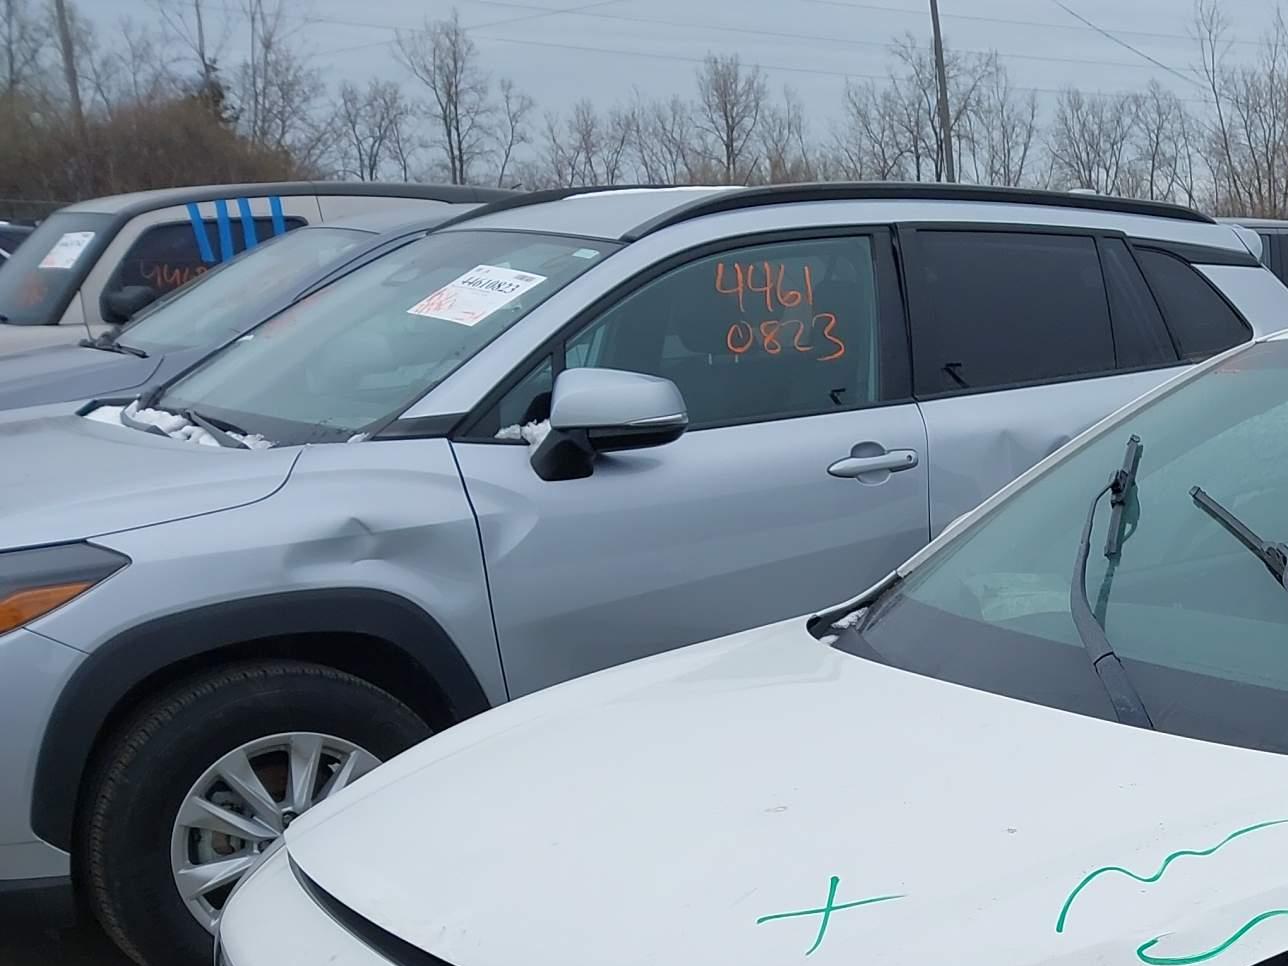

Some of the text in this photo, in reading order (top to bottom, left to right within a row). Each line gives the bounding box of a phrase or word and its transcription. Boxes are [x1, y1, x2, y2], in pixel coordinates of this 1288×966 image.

[461, 276, 521, 294] 44610823
[715, 262, 814, 313] 4461
[727, 313, 846, 361] 0823
